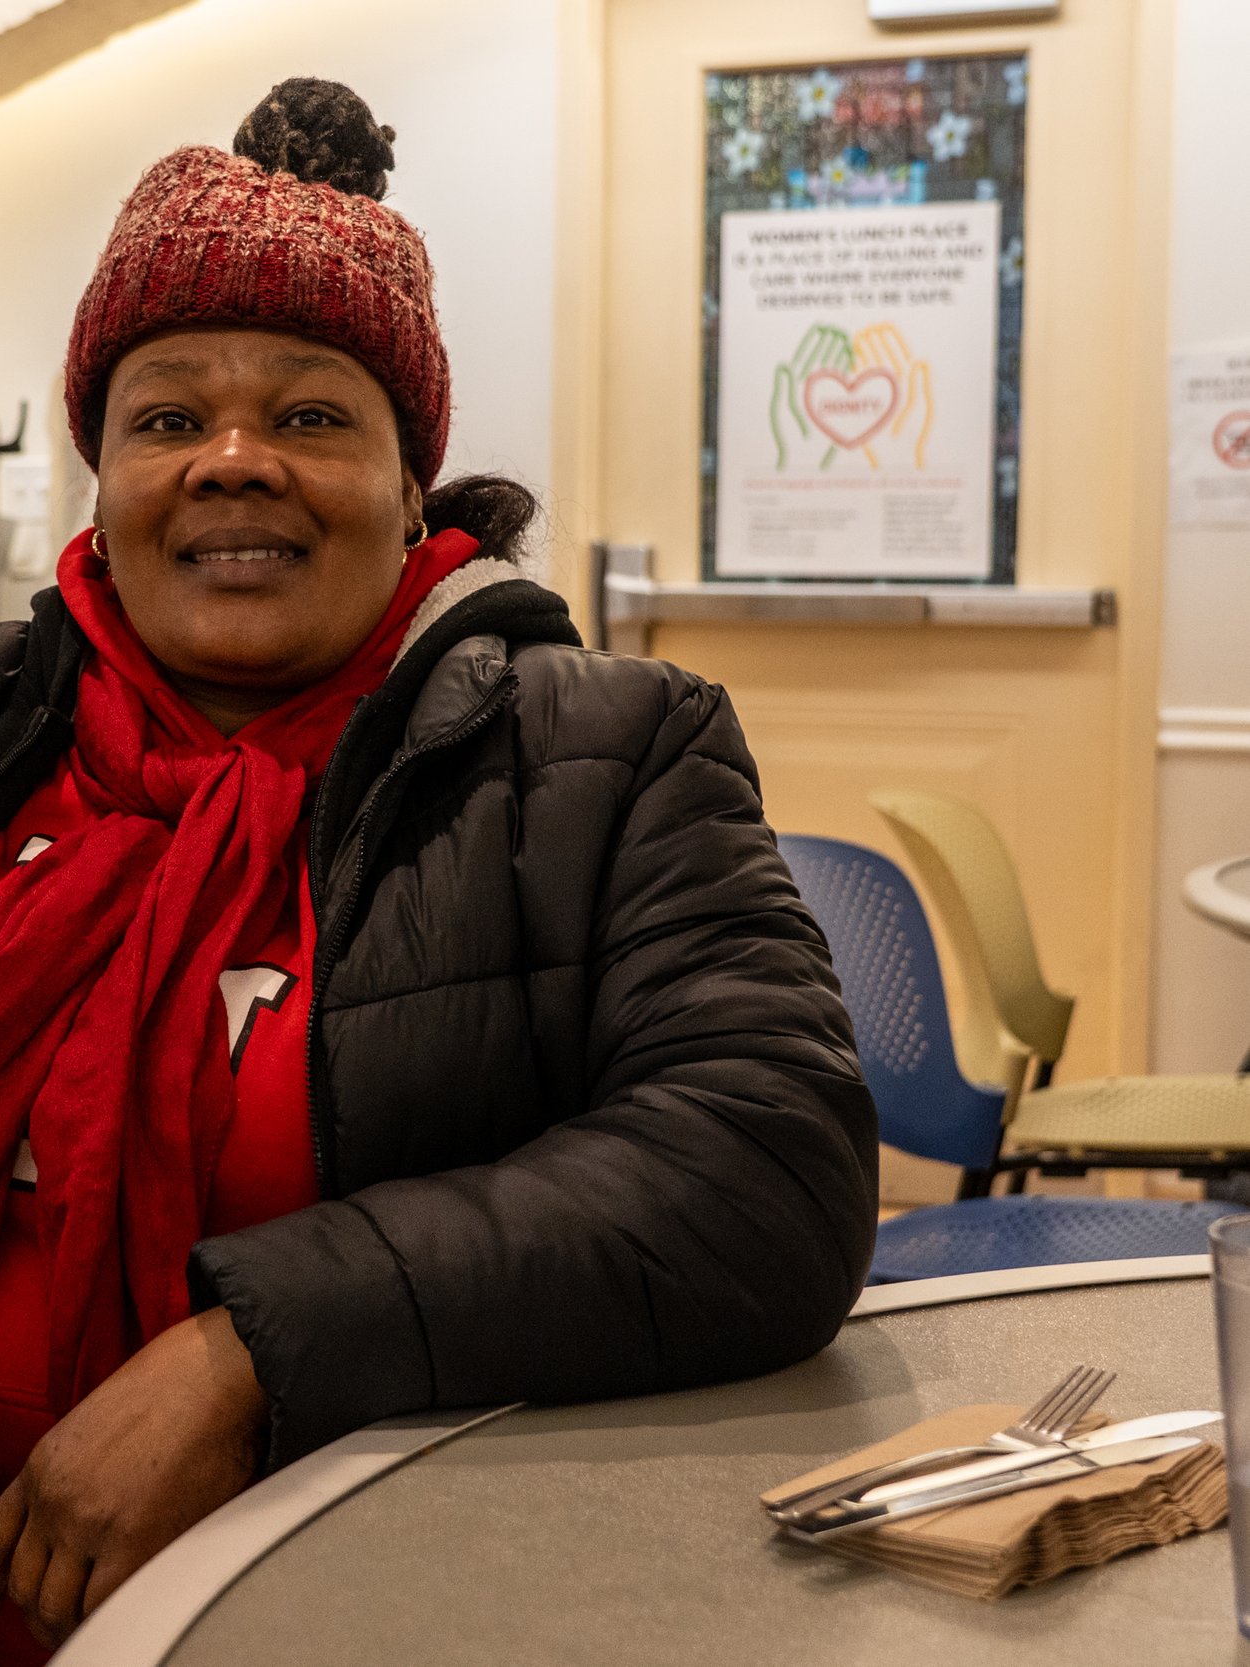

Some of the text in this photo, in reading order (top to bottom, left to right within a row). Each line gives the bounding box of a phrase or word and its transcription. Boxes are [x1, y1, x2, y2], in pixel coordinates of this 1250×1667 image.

[841, 223, 905, 242] LUNCH
[910, 220, 968, 240] PLACE
[769, 249, 830, 266] PLACE
[859, 244, 939, 262] HEALING
[945, 242, 985, 259] AND
[801, 269, 864, 286] WHERE
[868, 266, 965, 283] EVERYONE
[757, 290, 846, 310] DESERVES
[878, 289, 903, 306] BE
